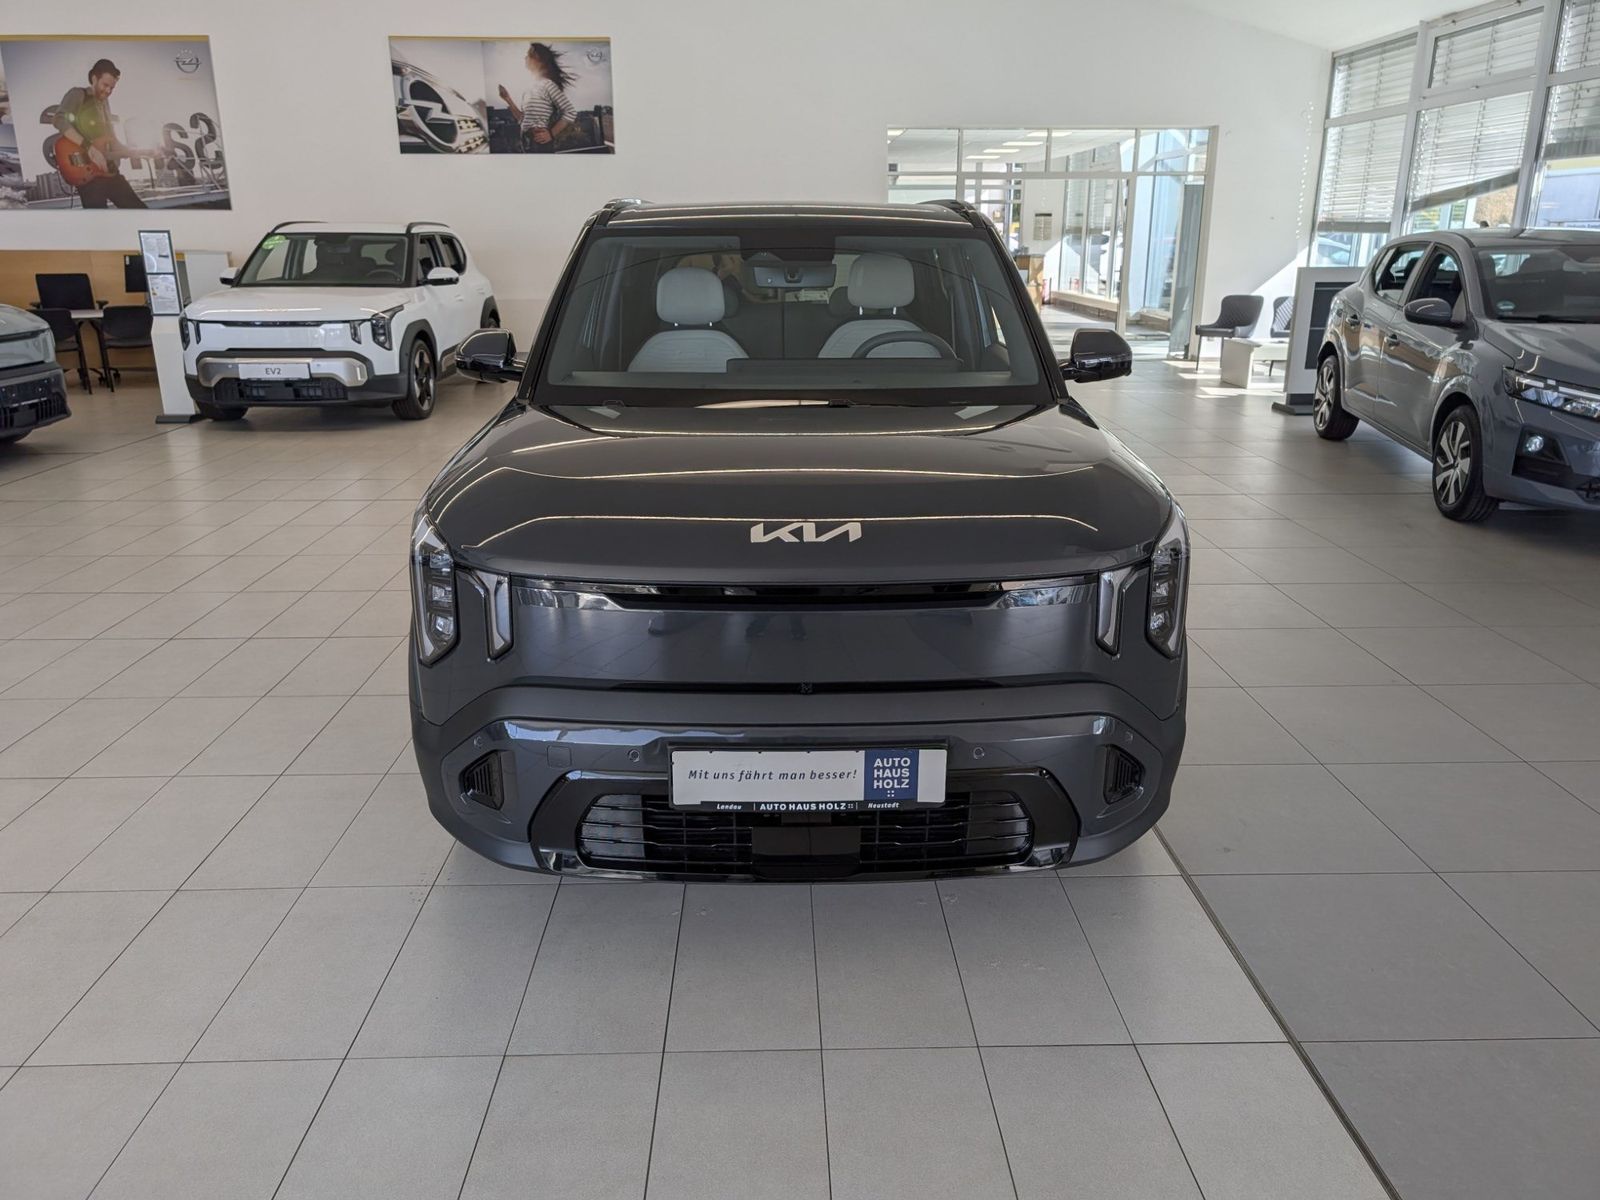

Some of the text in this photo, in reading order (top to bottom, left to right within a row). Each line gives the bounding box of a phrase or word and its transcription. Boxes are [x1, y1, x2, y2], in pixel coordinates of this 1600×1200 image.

[265, 367, 282, 375] EV2
[750, 522, 862, 543] KIA
[873, 757, 911, 767] AUTO
[688, 769, 857, 782] Mit uns fährt man besser!
[873, 768, 910, 778] HAUS
[873, 779, 910, 789] HOLZ
[760, 802, 847, 811] AUTO HAUS HOLZ
